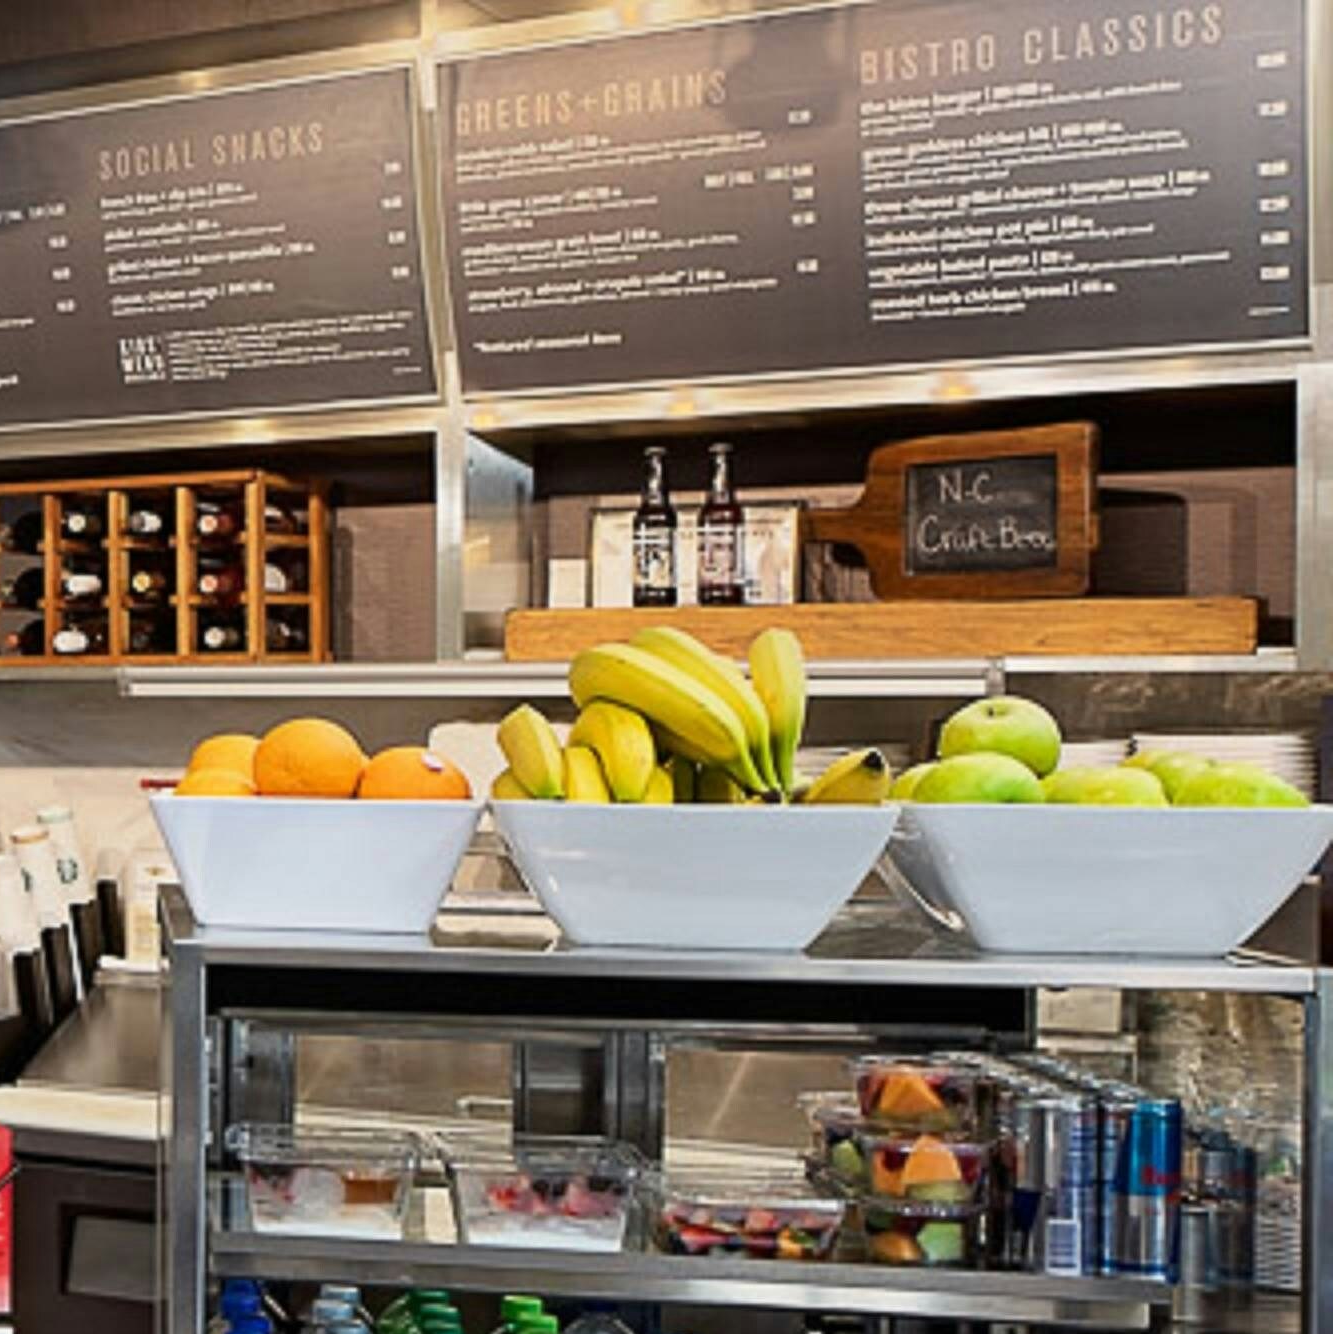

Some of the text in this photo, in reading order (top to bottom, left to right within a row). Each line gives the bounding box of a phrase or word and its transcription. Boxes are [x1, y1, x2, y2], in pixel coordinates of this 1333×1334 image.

[859, 6, 1224, 85] BISTRO CLASSICS
[99, 122, 324, 181] SOCIAL SNACKS
